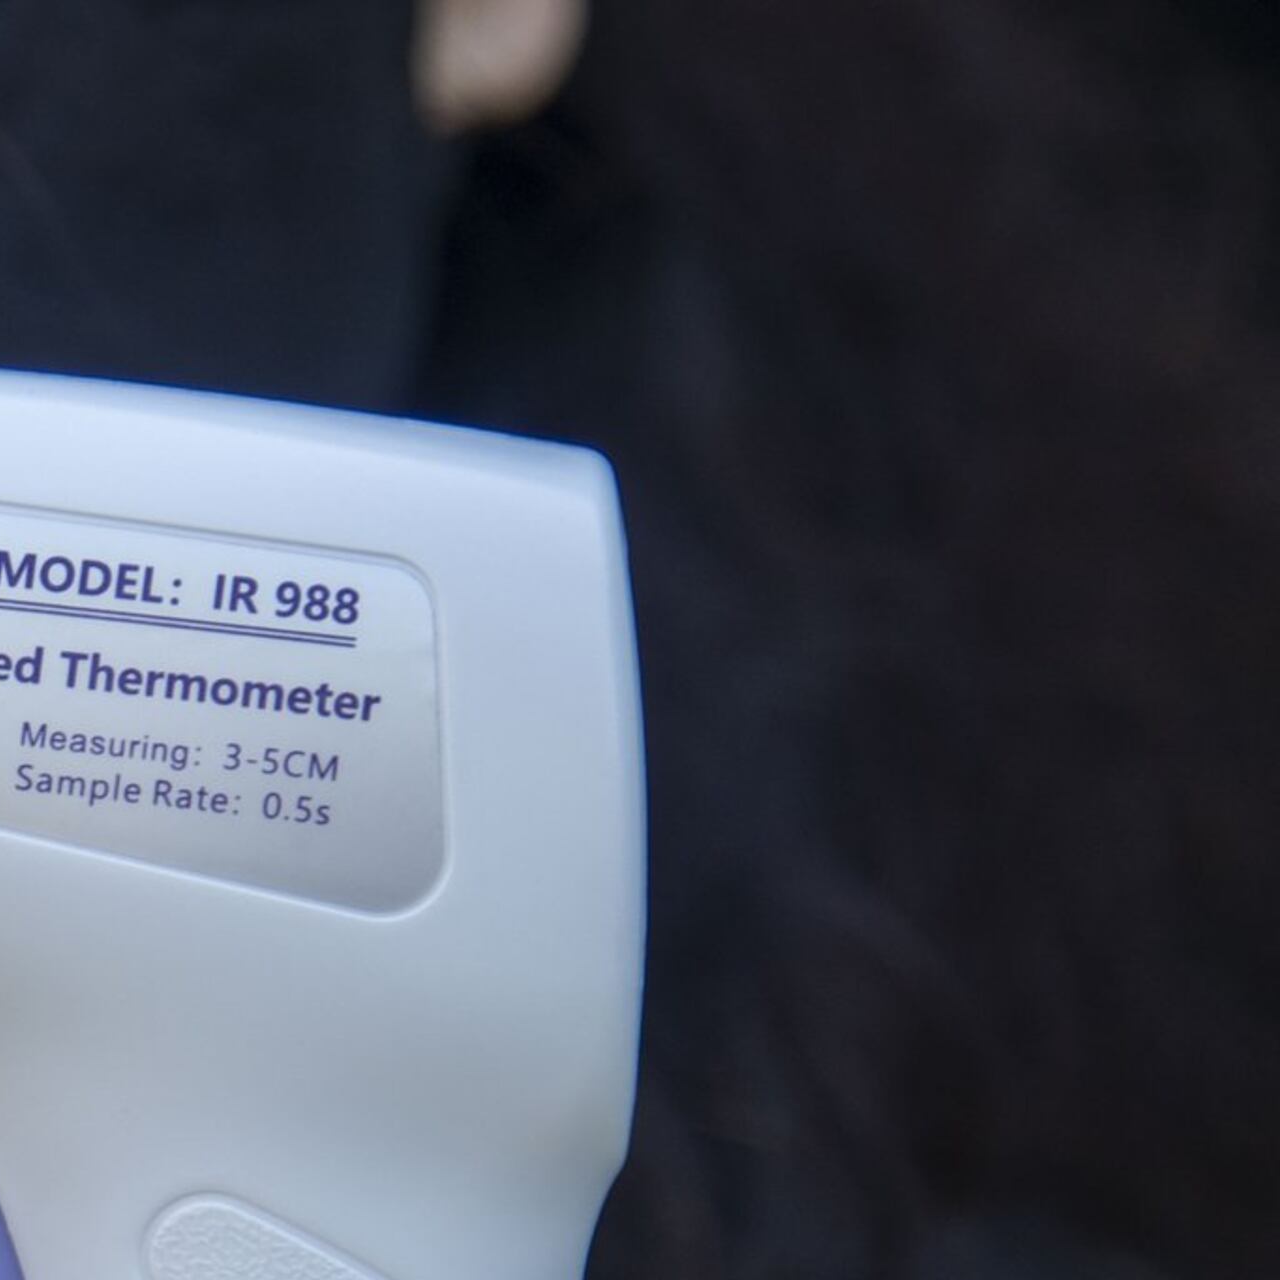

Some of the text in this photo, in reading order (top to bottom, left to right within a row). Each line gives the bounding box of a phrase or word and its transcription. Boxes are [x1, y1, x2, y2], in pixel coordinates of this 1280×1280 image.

[211, 574, 259, 614] IR
[274, 581, 361, 625] 988
[60, 651, 382, 722] Thermometer
[19, 722, 340, 782] Measuring: 3-5CM
[15, 765, 332, 826] Sample Rate: 0.5s
